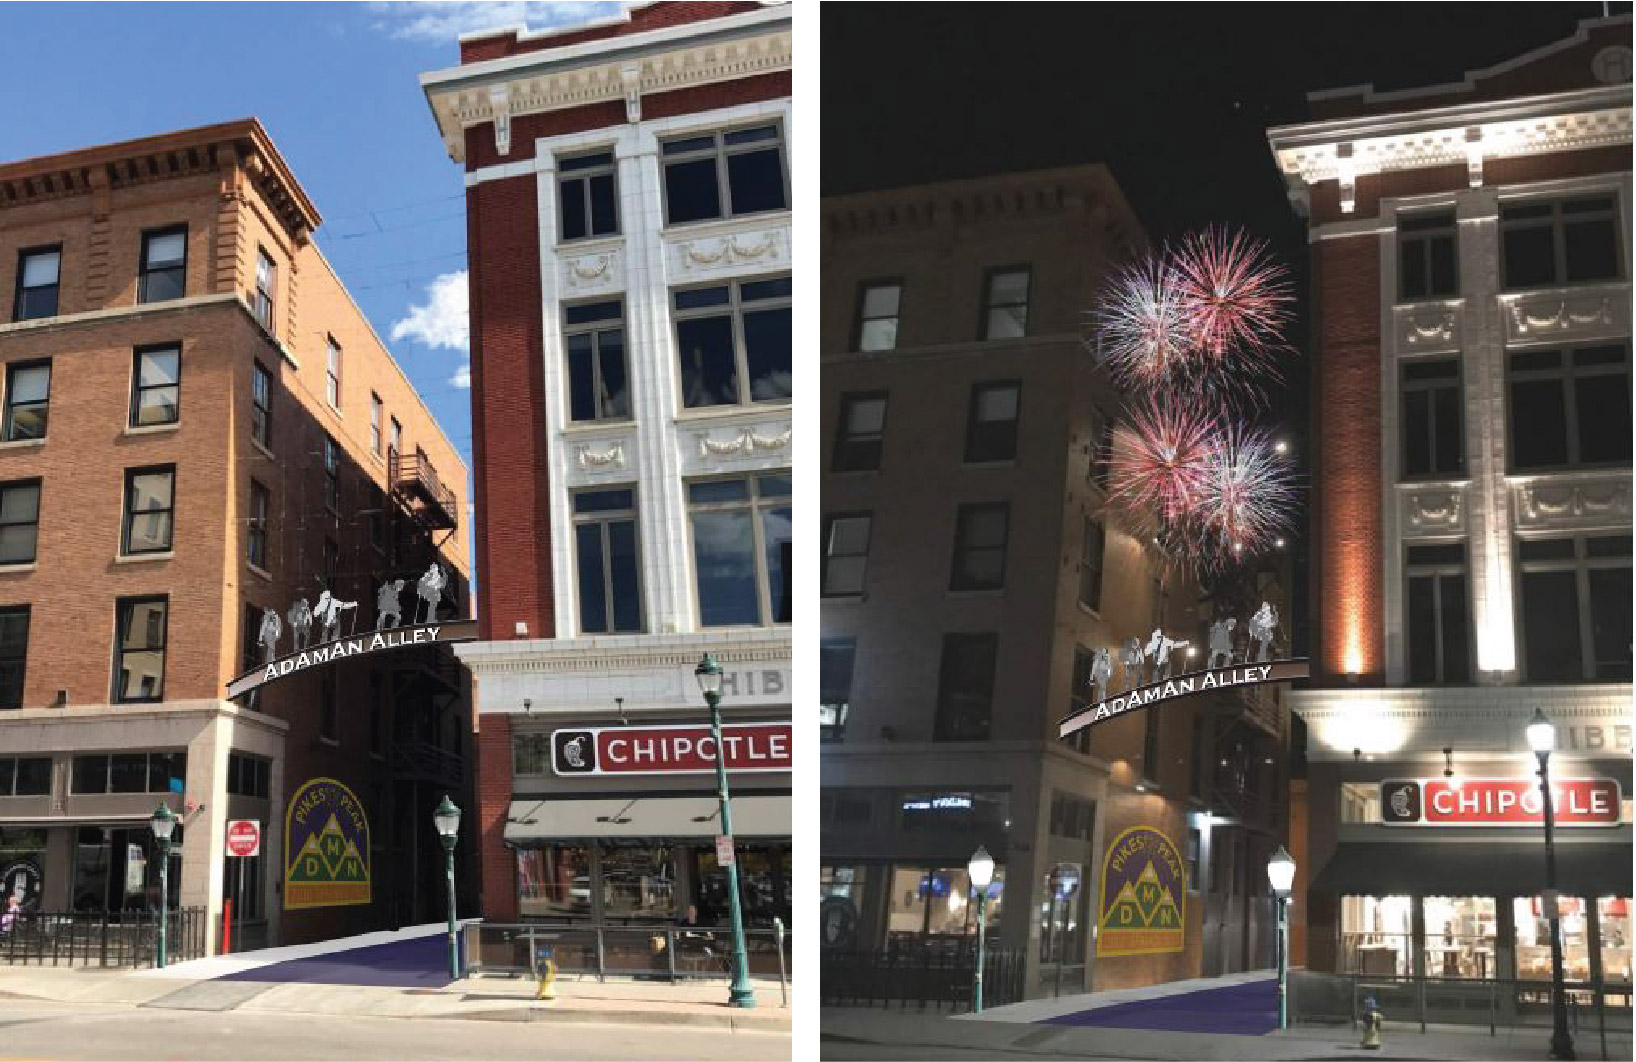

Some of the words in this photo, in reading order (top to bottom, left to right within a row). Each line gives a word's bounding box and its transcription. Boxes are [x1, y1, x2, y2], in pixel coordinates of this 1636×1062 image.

[370, 627, 441, 650] ALLEY
[1202, 665, 1272, 689] ALLEY
[607, 734, 790, 763] CHIPOTLE
